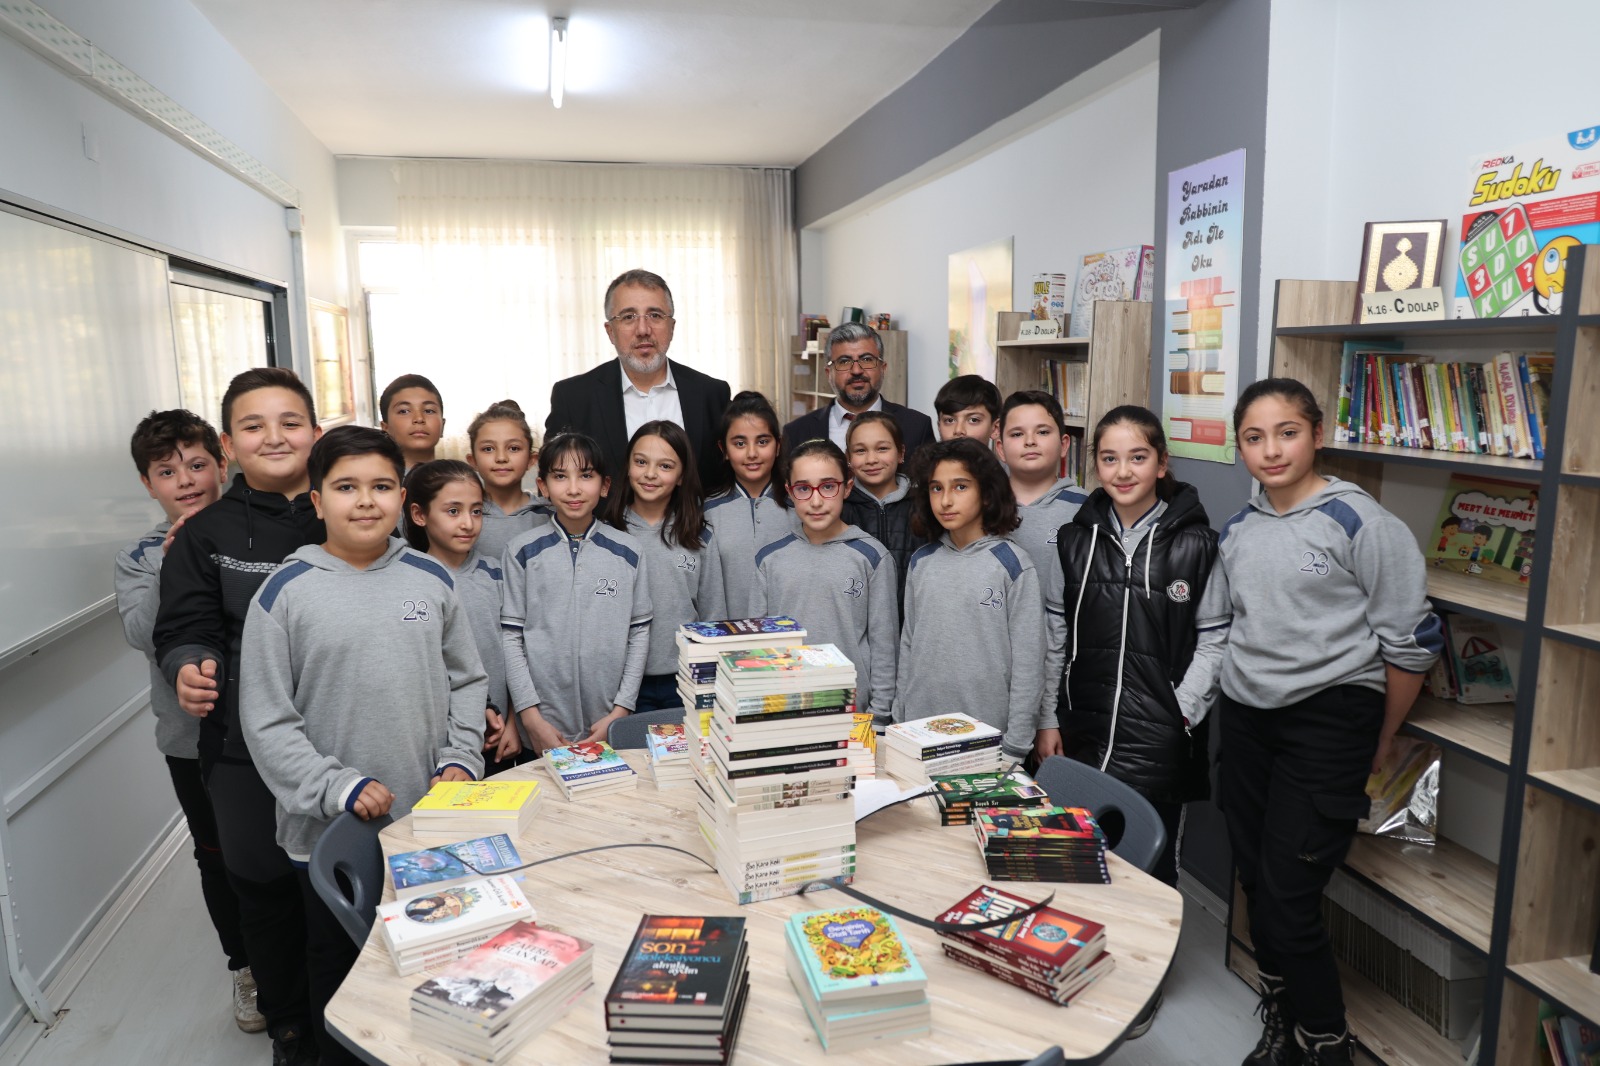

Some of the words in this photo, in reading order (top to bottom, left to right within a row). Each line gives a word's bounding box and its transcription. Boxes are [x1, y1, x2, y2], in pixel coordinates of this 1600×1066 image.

[1481, 155, 1515, 170] REDKA
[1182, 174, 1229, 202] Yaradan
[1179, 200, 1229, 226] Rabbinin
[1485, 227, 1496, 252] U
[1191, 254, 1213, 272] Oku
[1474, 268, 1485, 292] 3
[1494, 252, 1505, 277] D
[1502, 277, 1513, 301] U
[1394, 298, 1405, 314] C
[1407, 301, 1440, 313] DOLAP
[1457, 502, 1482, 513] MERT
[1300, 551, 1329, 575] 23
[596, 578, 617, 597] 23
[844, 577, 863, 598] 23
[980, 587, 1003, 610] 23
[402, 600, 429, 621] 23
[640, 941, 687, 954] son
